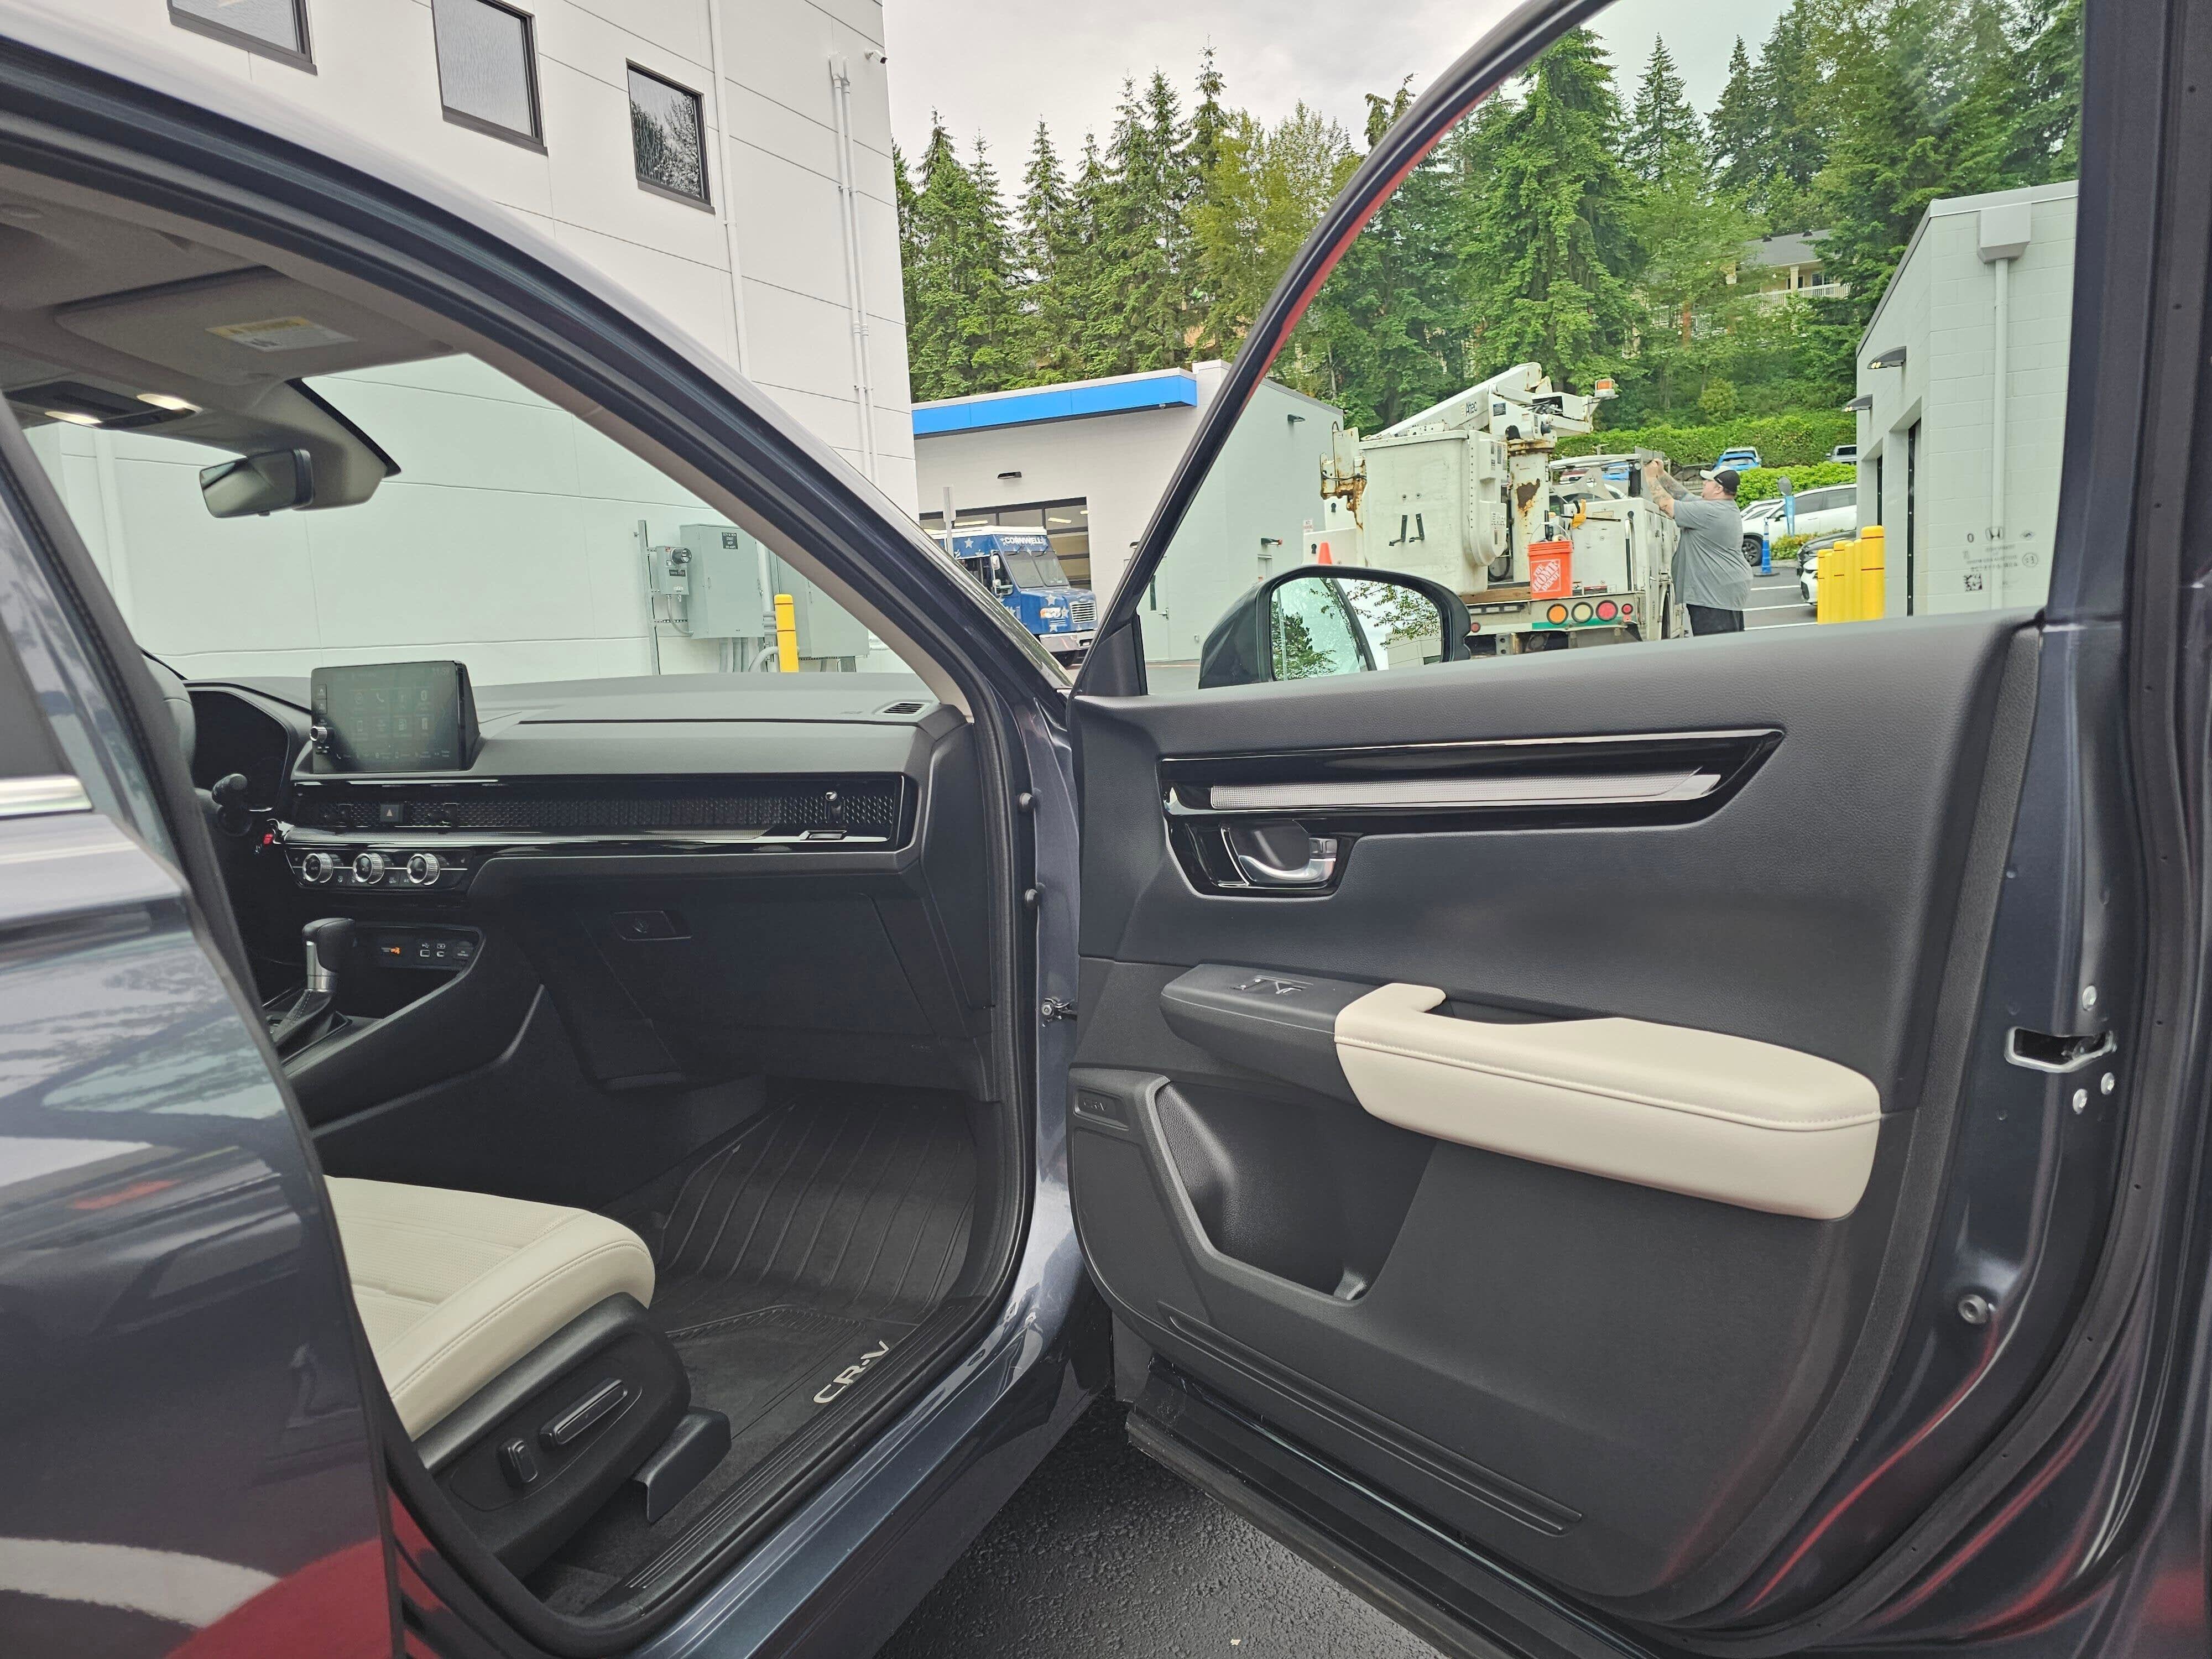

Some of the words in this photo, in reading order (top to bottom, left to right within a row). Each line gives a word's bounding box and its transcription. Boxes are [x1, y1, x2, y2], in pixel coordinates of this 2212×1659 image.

[1465, 401, 1478, 416] Altec
[1532, 564, 1545, 577] THE
[1532, 562, 1558, 592] HOME
[1541, 571, 1560, 591] DEPOT
[813, 1340, 889, 1404] CR-V
